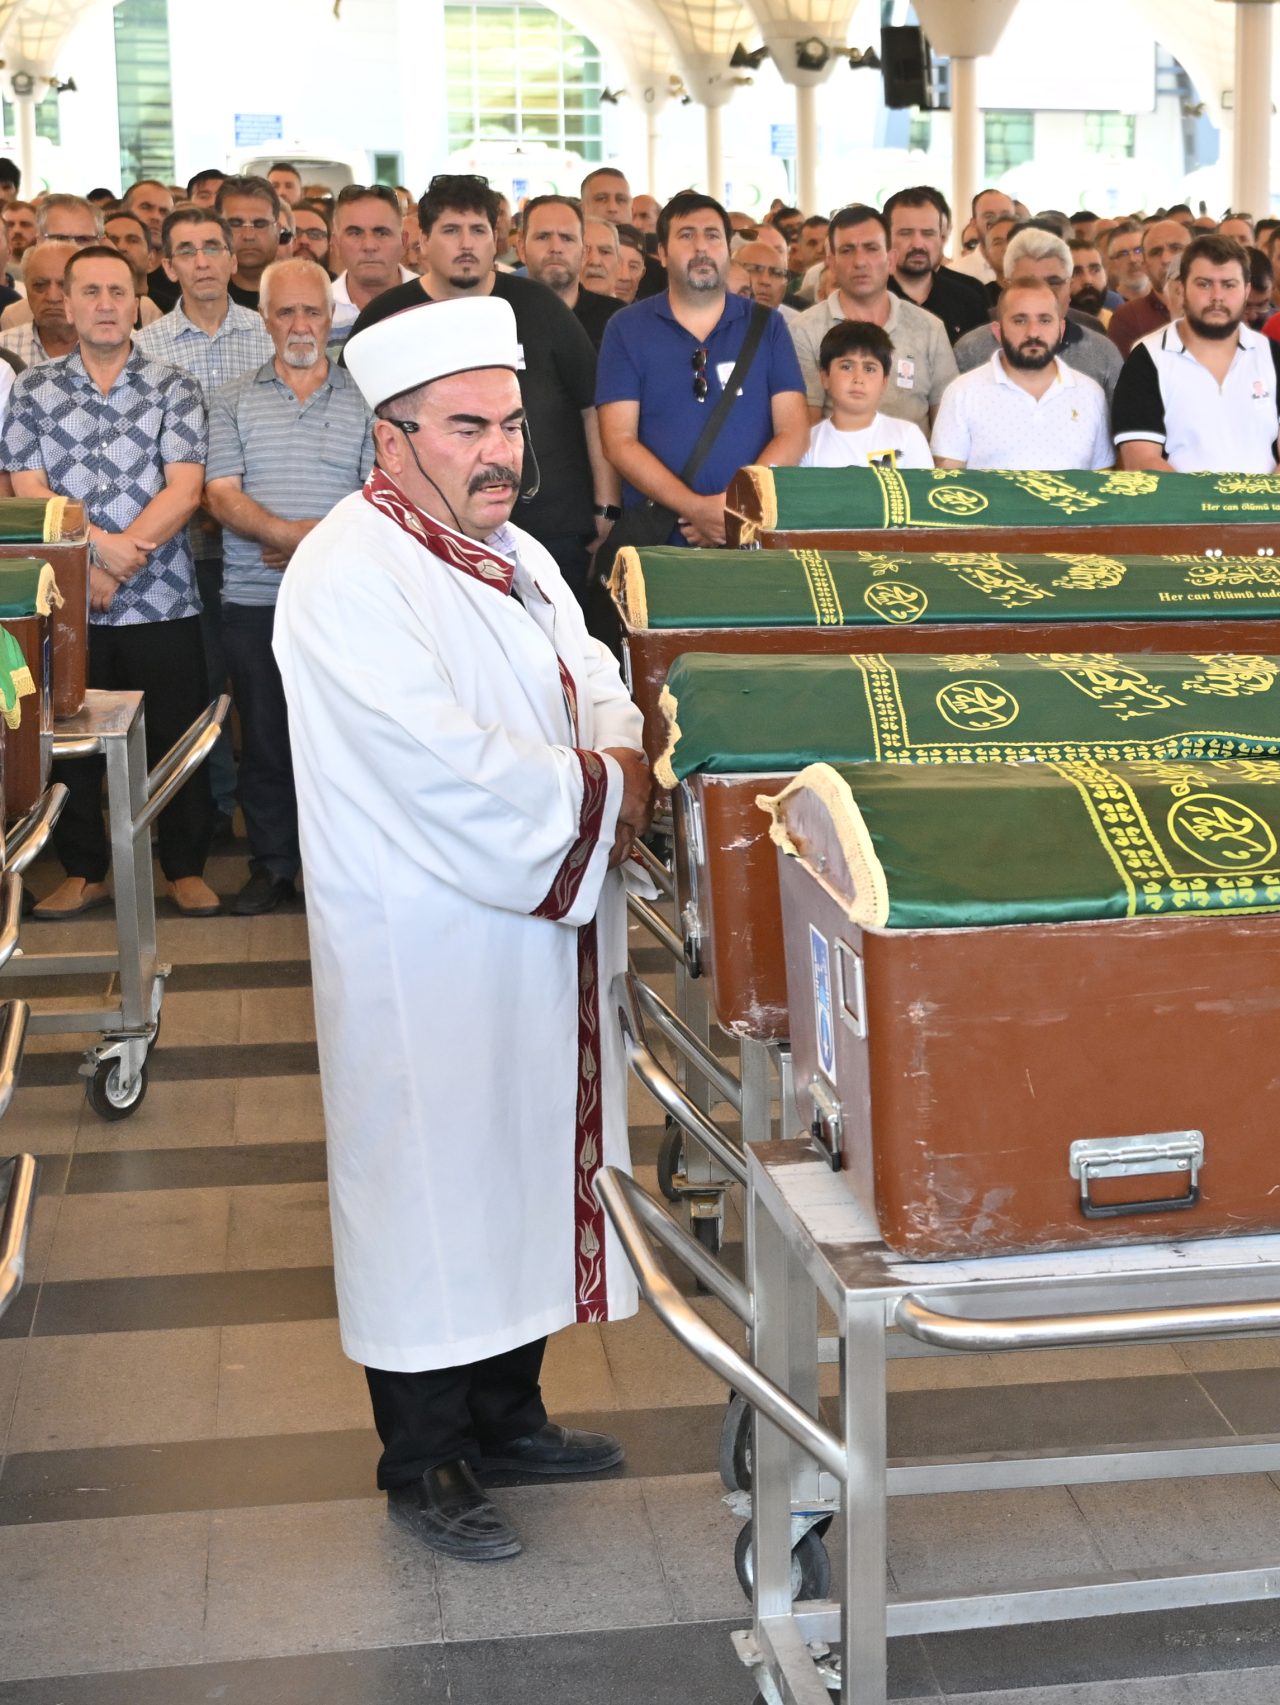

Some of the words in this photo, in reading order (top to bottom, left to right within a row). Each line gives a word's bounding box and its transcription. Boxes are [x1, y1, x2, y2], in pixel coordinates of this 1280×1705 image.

[1201, 503, 1220, 511] Her
[1158, 592, 1183, 602] Her
[1187, 592, 1210, 601] can
[1213, 590, 1254, 600] ölümü
